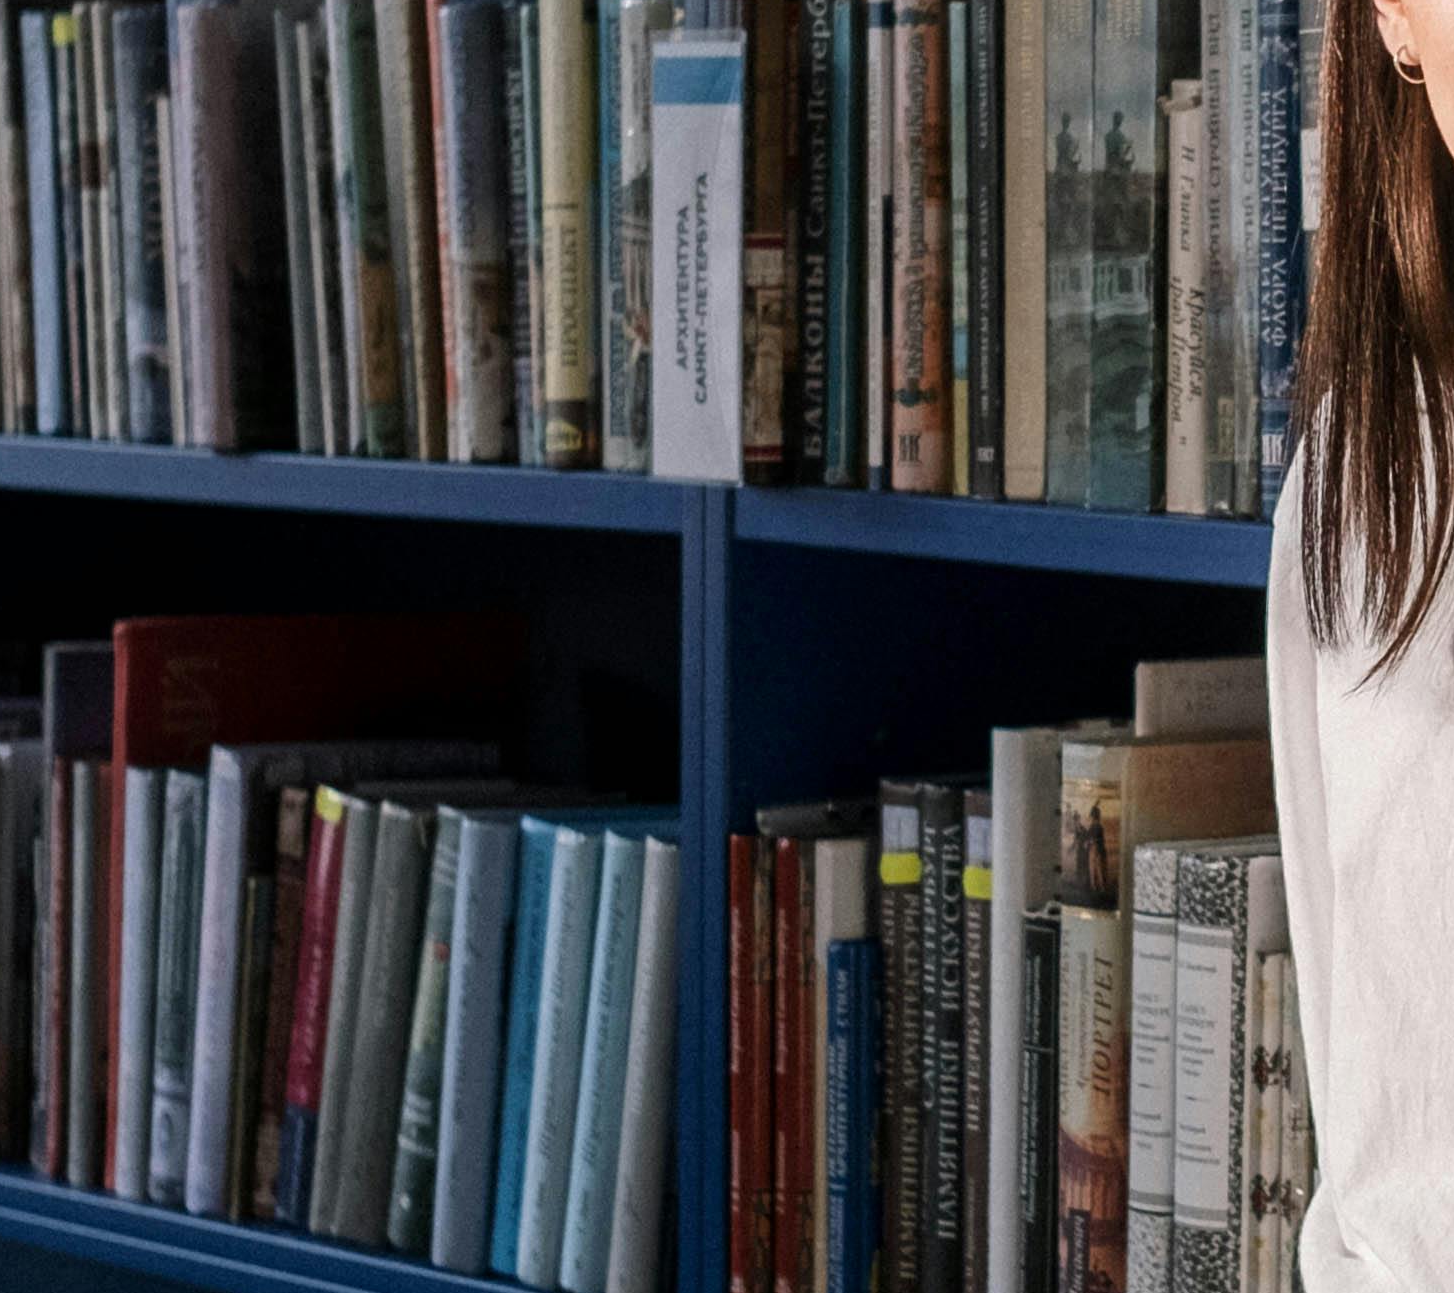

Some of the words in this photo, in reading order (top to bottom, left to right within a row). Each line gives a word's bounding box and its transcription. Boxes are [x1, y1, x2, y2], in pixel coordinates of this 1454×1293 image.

[1271, 85, 1289, 245] ПЕТЕРБУРГА
[559, 225, 578, 368] ПРОСПЕКТ
[676, 205, 689, 371] АРХИТЕКТУРА
[694, 171, 708, 405] САНКТ-ПЕТЕРБУРГА
[803, 253, 825, 460] БАЛКОНЫ
[1270, 257, 1288, 348] ФЛОРА
[901, 892, 920, 1092] АРХИТЕКТУРЫ
[939, 824, 963, 1011] ИСКУССТВА
[965, 901, 982, 1133] ПЕТЕРБУРГСКИЕ
[1091, 948, 1113, 1097] ПОРТРЕТ
[899, 1105, 918, 1280] ПАМЯТНИКИ
[937, 1039, 958, 1241] ПАМЯТНИКИ
